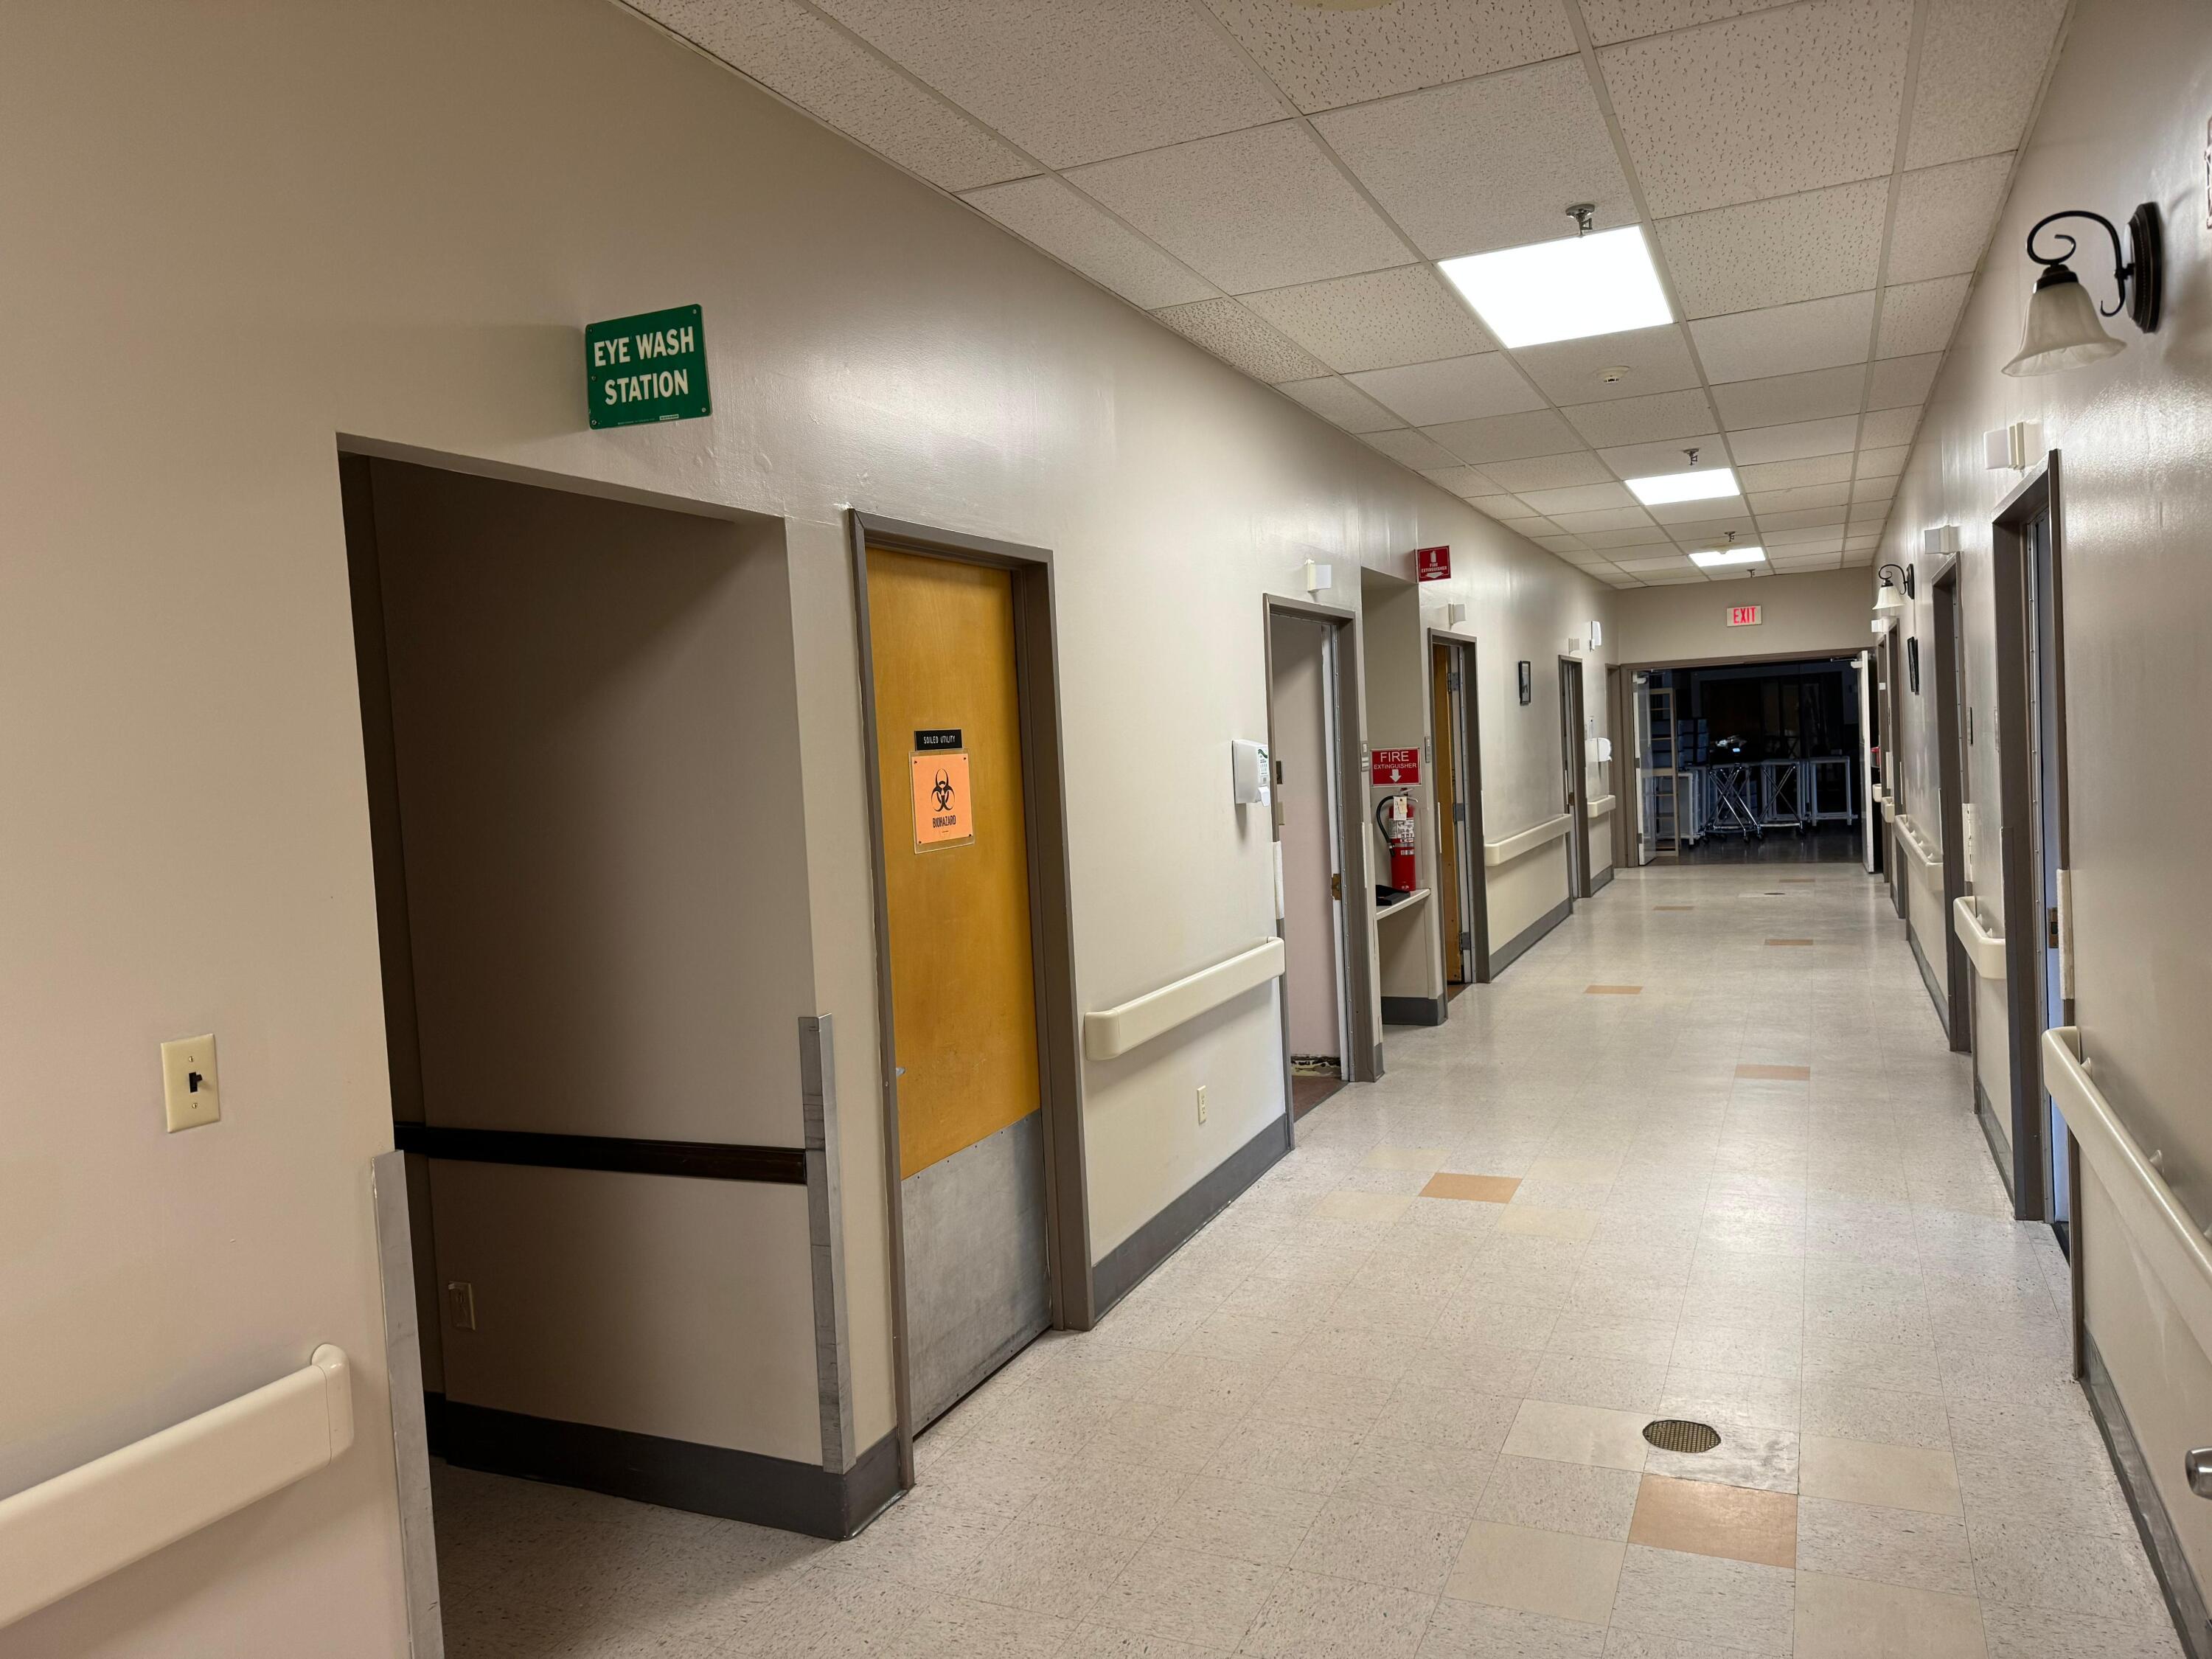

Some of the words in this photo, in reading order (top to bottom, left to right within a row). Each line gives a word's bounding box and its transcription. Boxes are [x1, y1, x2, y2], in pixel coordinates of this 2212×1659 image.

[594, 337, 630, 367] EYE
[636, 326, 695, 360] WASH
[605, 369, 689, 405] STATION
[1733, 607, 1756, 624] EXIT
[923, 736, 939, 744] SOILED
[940, 735, 956, 743] UTILITY
[1380, 751, 1409, 762] FIRE
[932, 815, 956, 828] BIOHAZARD
